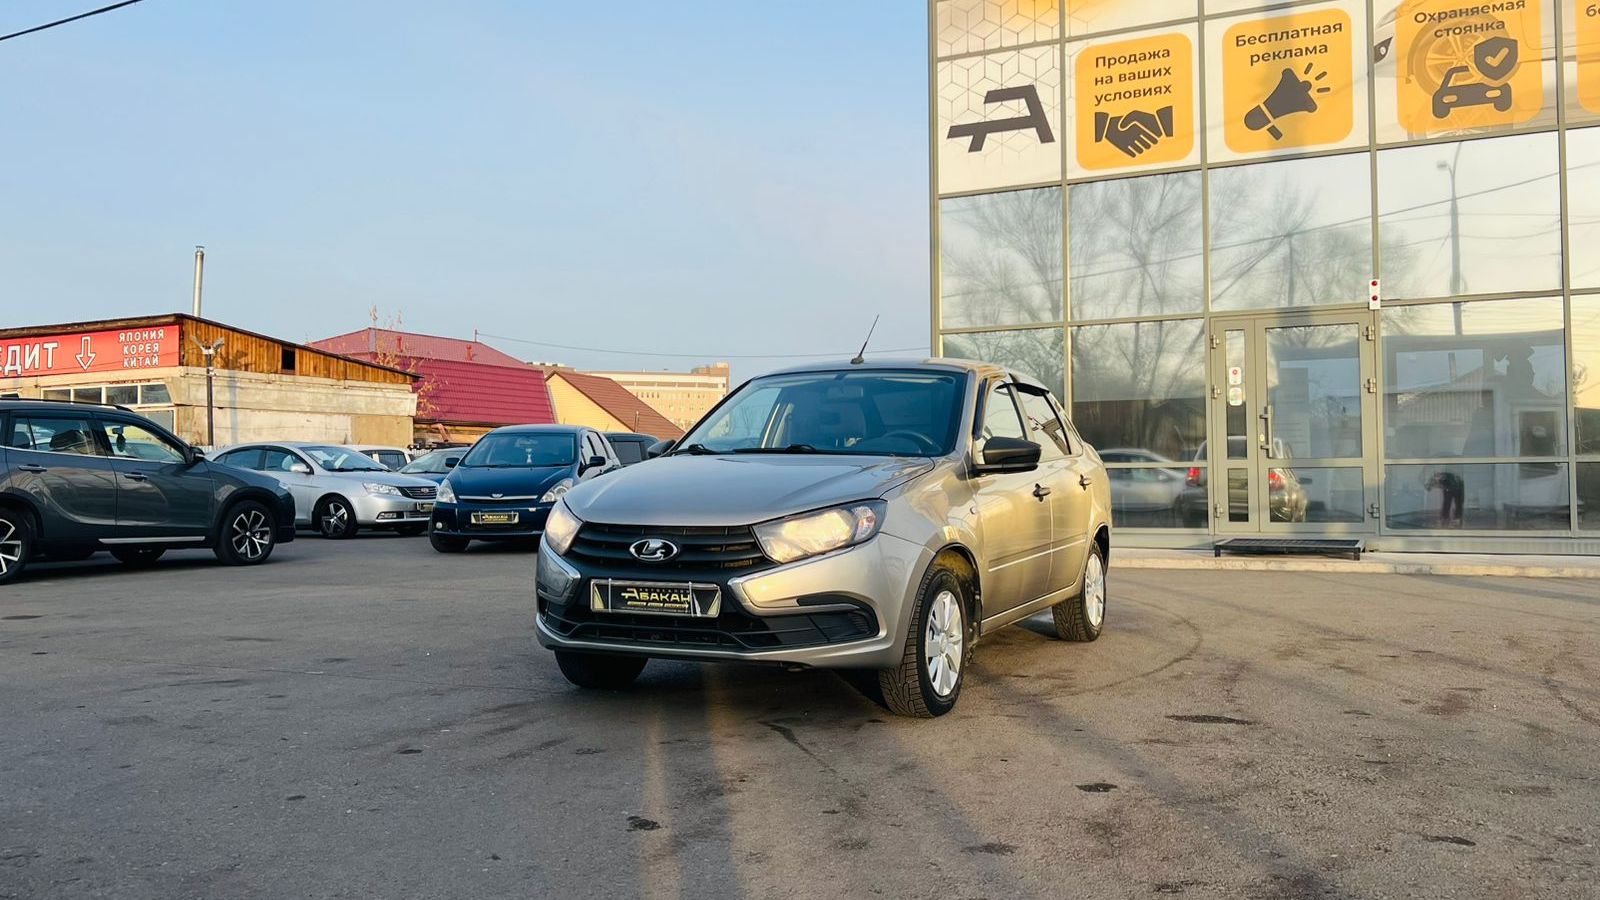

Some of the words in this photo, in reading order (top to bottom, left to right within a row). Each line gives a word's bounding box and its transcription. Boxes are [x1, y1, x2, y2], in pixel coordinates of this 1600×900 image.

[1414, 0, 1526, 23] Охраняемая
[1586, 4, 1600, 17] б
[1235, 22, 1343, 47] Бесплатная
[1434, 20, 1505, 39] стоянка
[1095, 48, 1171, 69] Продажа
[1250, 43, 1328, 66] реклама
[1094, 75, 1113, 87] на
[1118, 66, 1172, 83] ваших
[1094, 84, 1172, 107] условиях
[119, 329, 165, 343] ЯПОНИЯ
[123, 342, 160, 355] КОРЕЯ
[0, 342, 59, 377] ДИТ
[123, 354, 160, 368] КИТАЙ
